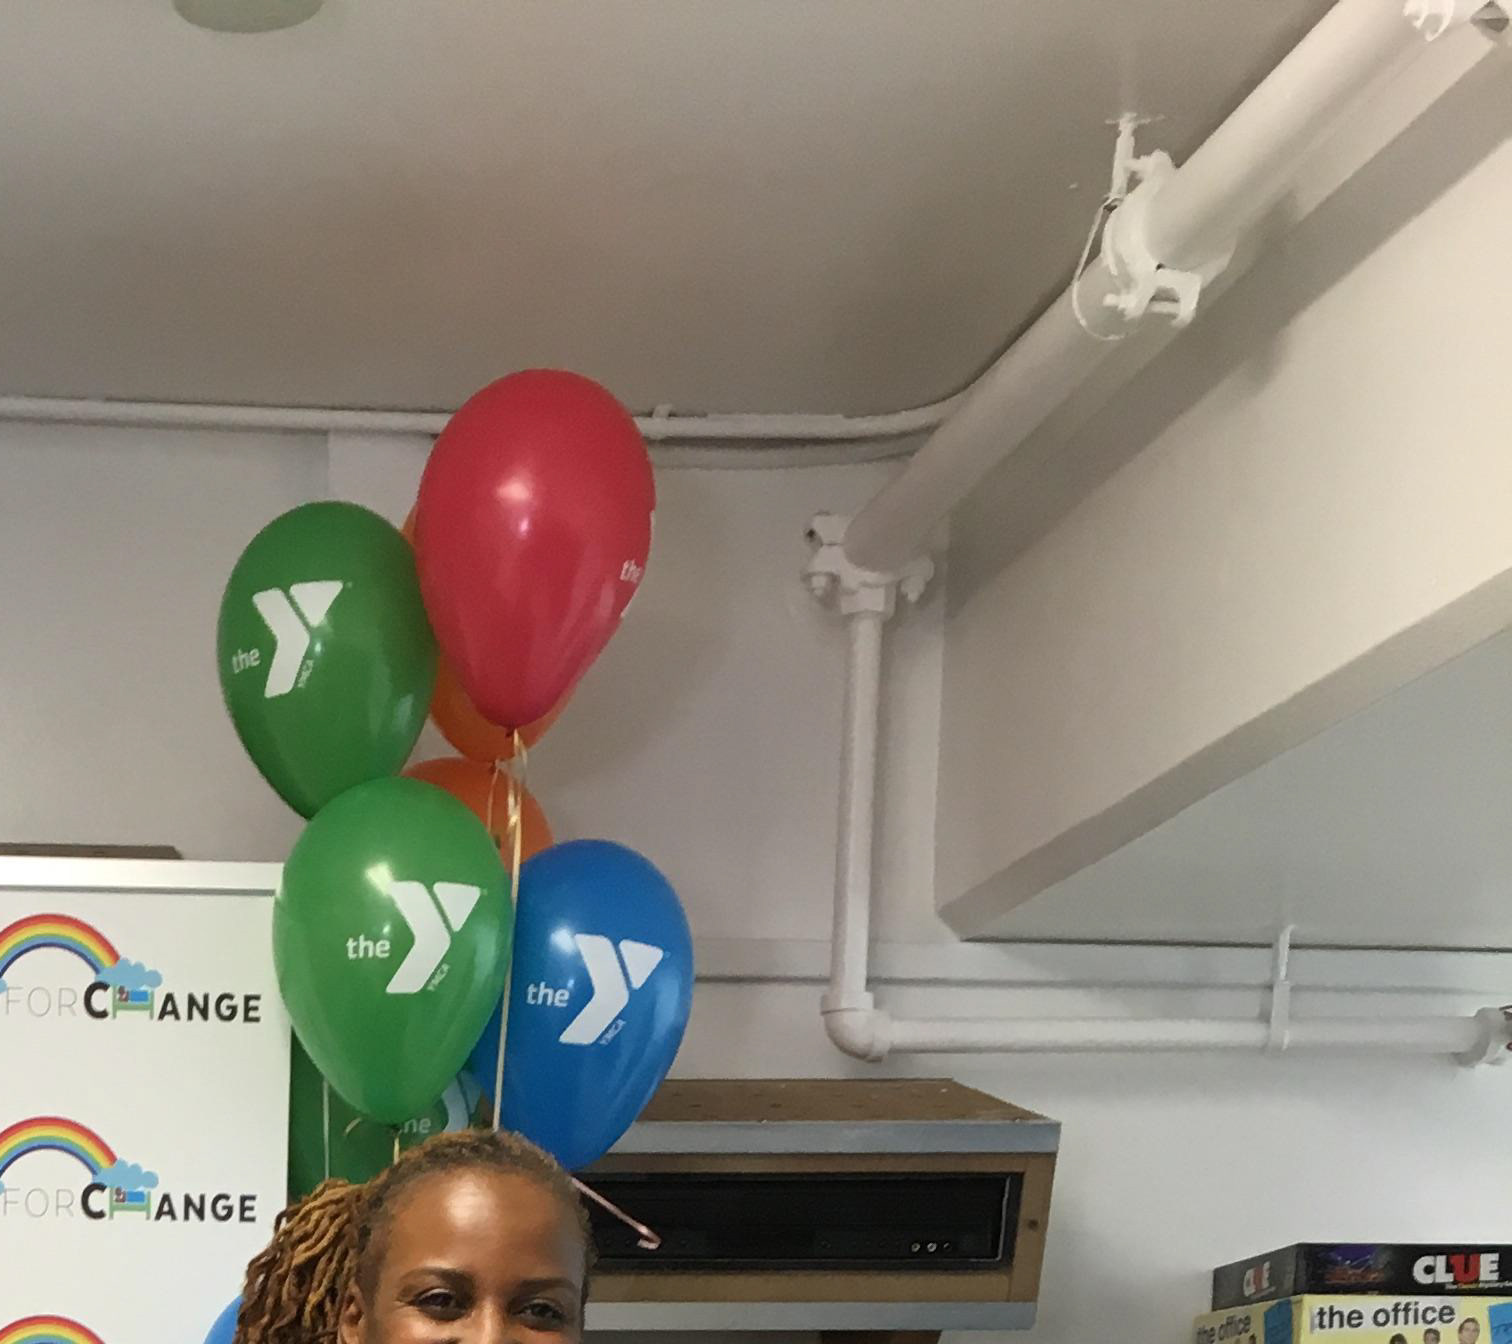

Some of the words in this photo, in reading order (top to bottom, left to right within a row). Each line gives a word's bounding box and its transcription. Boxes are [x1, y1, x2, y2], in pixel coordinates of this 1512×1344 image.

[232, 648, 260, 674] the
[346, 934, 390, 960] the
[526, 981, 570, 1008] the
[1413, 1252, 1500, 1285] CLUE
[1316, 1305, 1364, 1330] the
[1373, 1300, 1456, 1327] office
